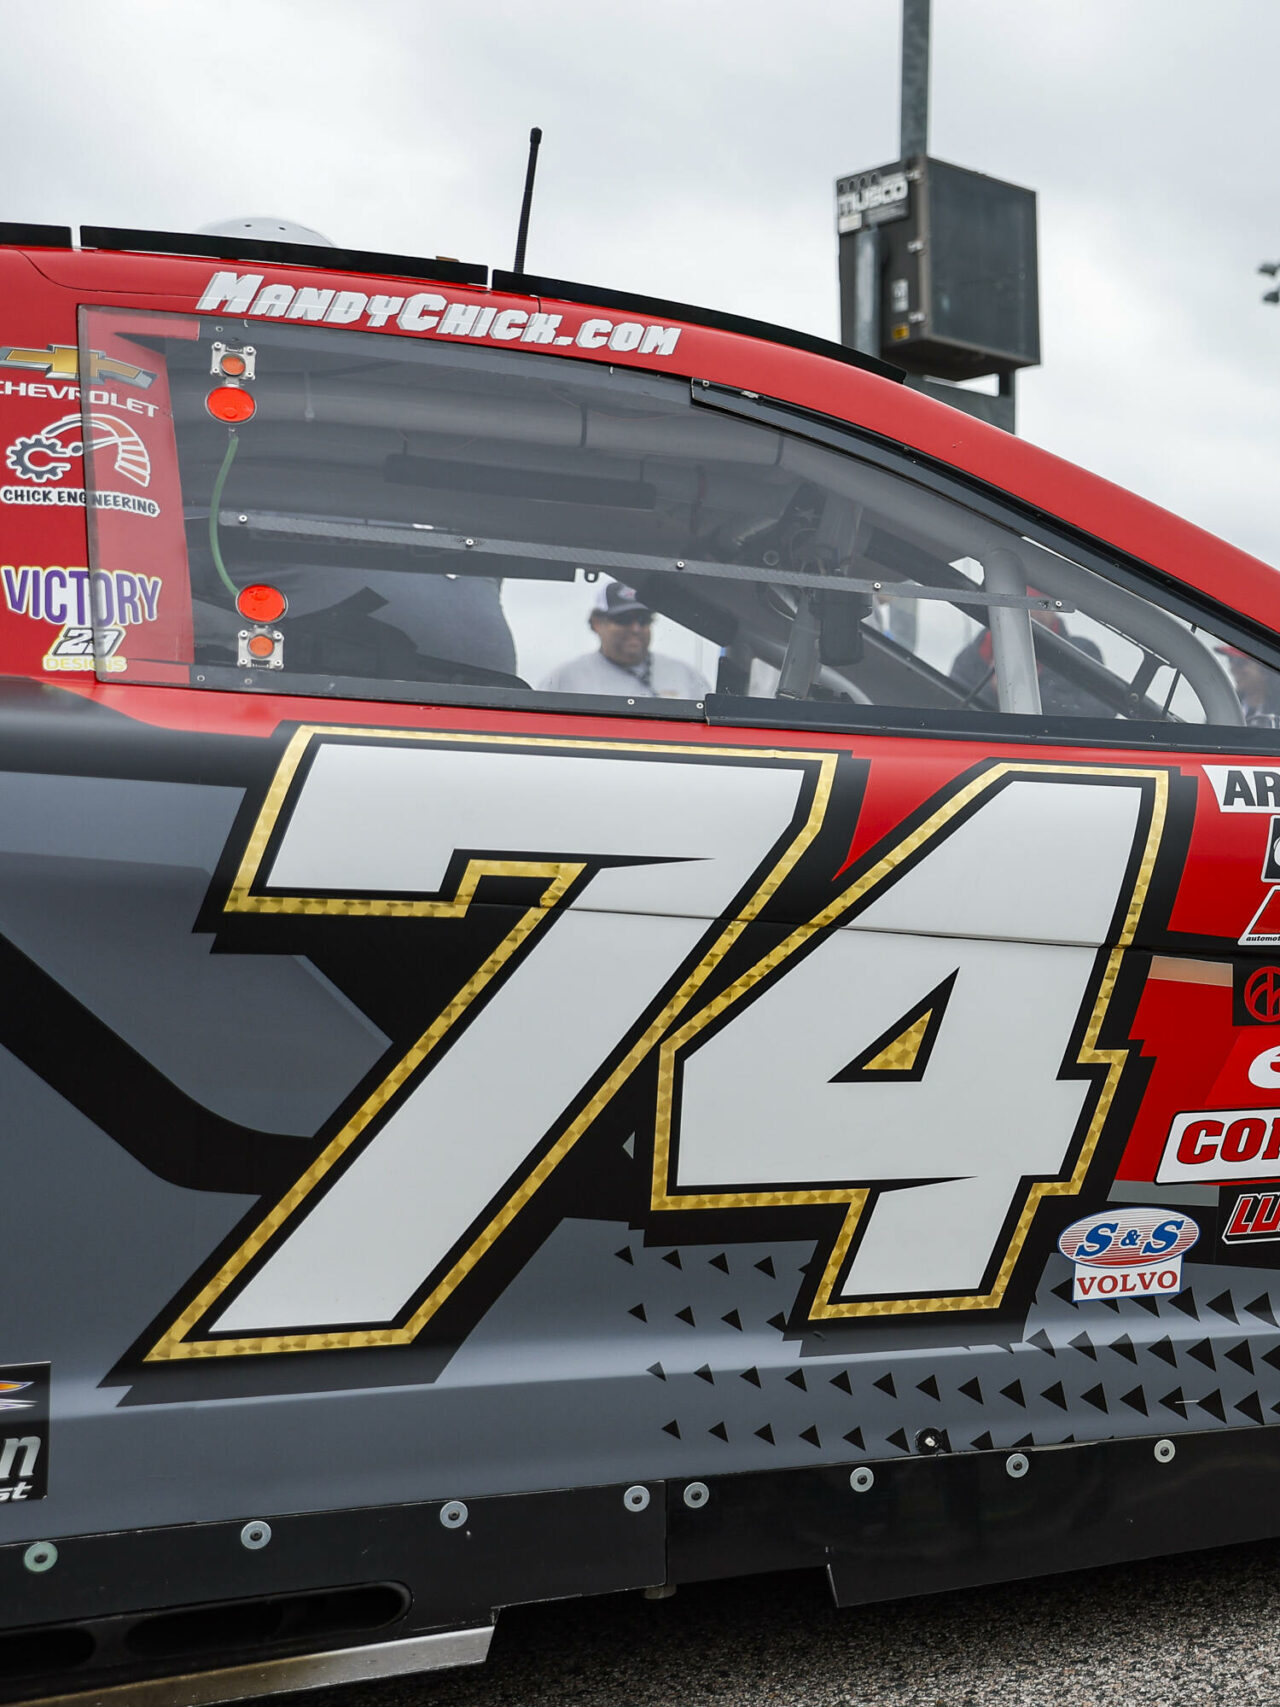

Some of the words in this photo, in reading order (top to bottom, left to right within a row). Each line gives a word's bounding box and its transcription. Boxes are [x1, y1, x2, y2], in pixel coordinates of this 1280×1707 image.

[3, 488, 52, 504] CHICK
[3, 568, 161, 626] VICTORY
[145, 724, 1169, 1362] 74
[1077, 1270, 1178, 1296] VOLVO
